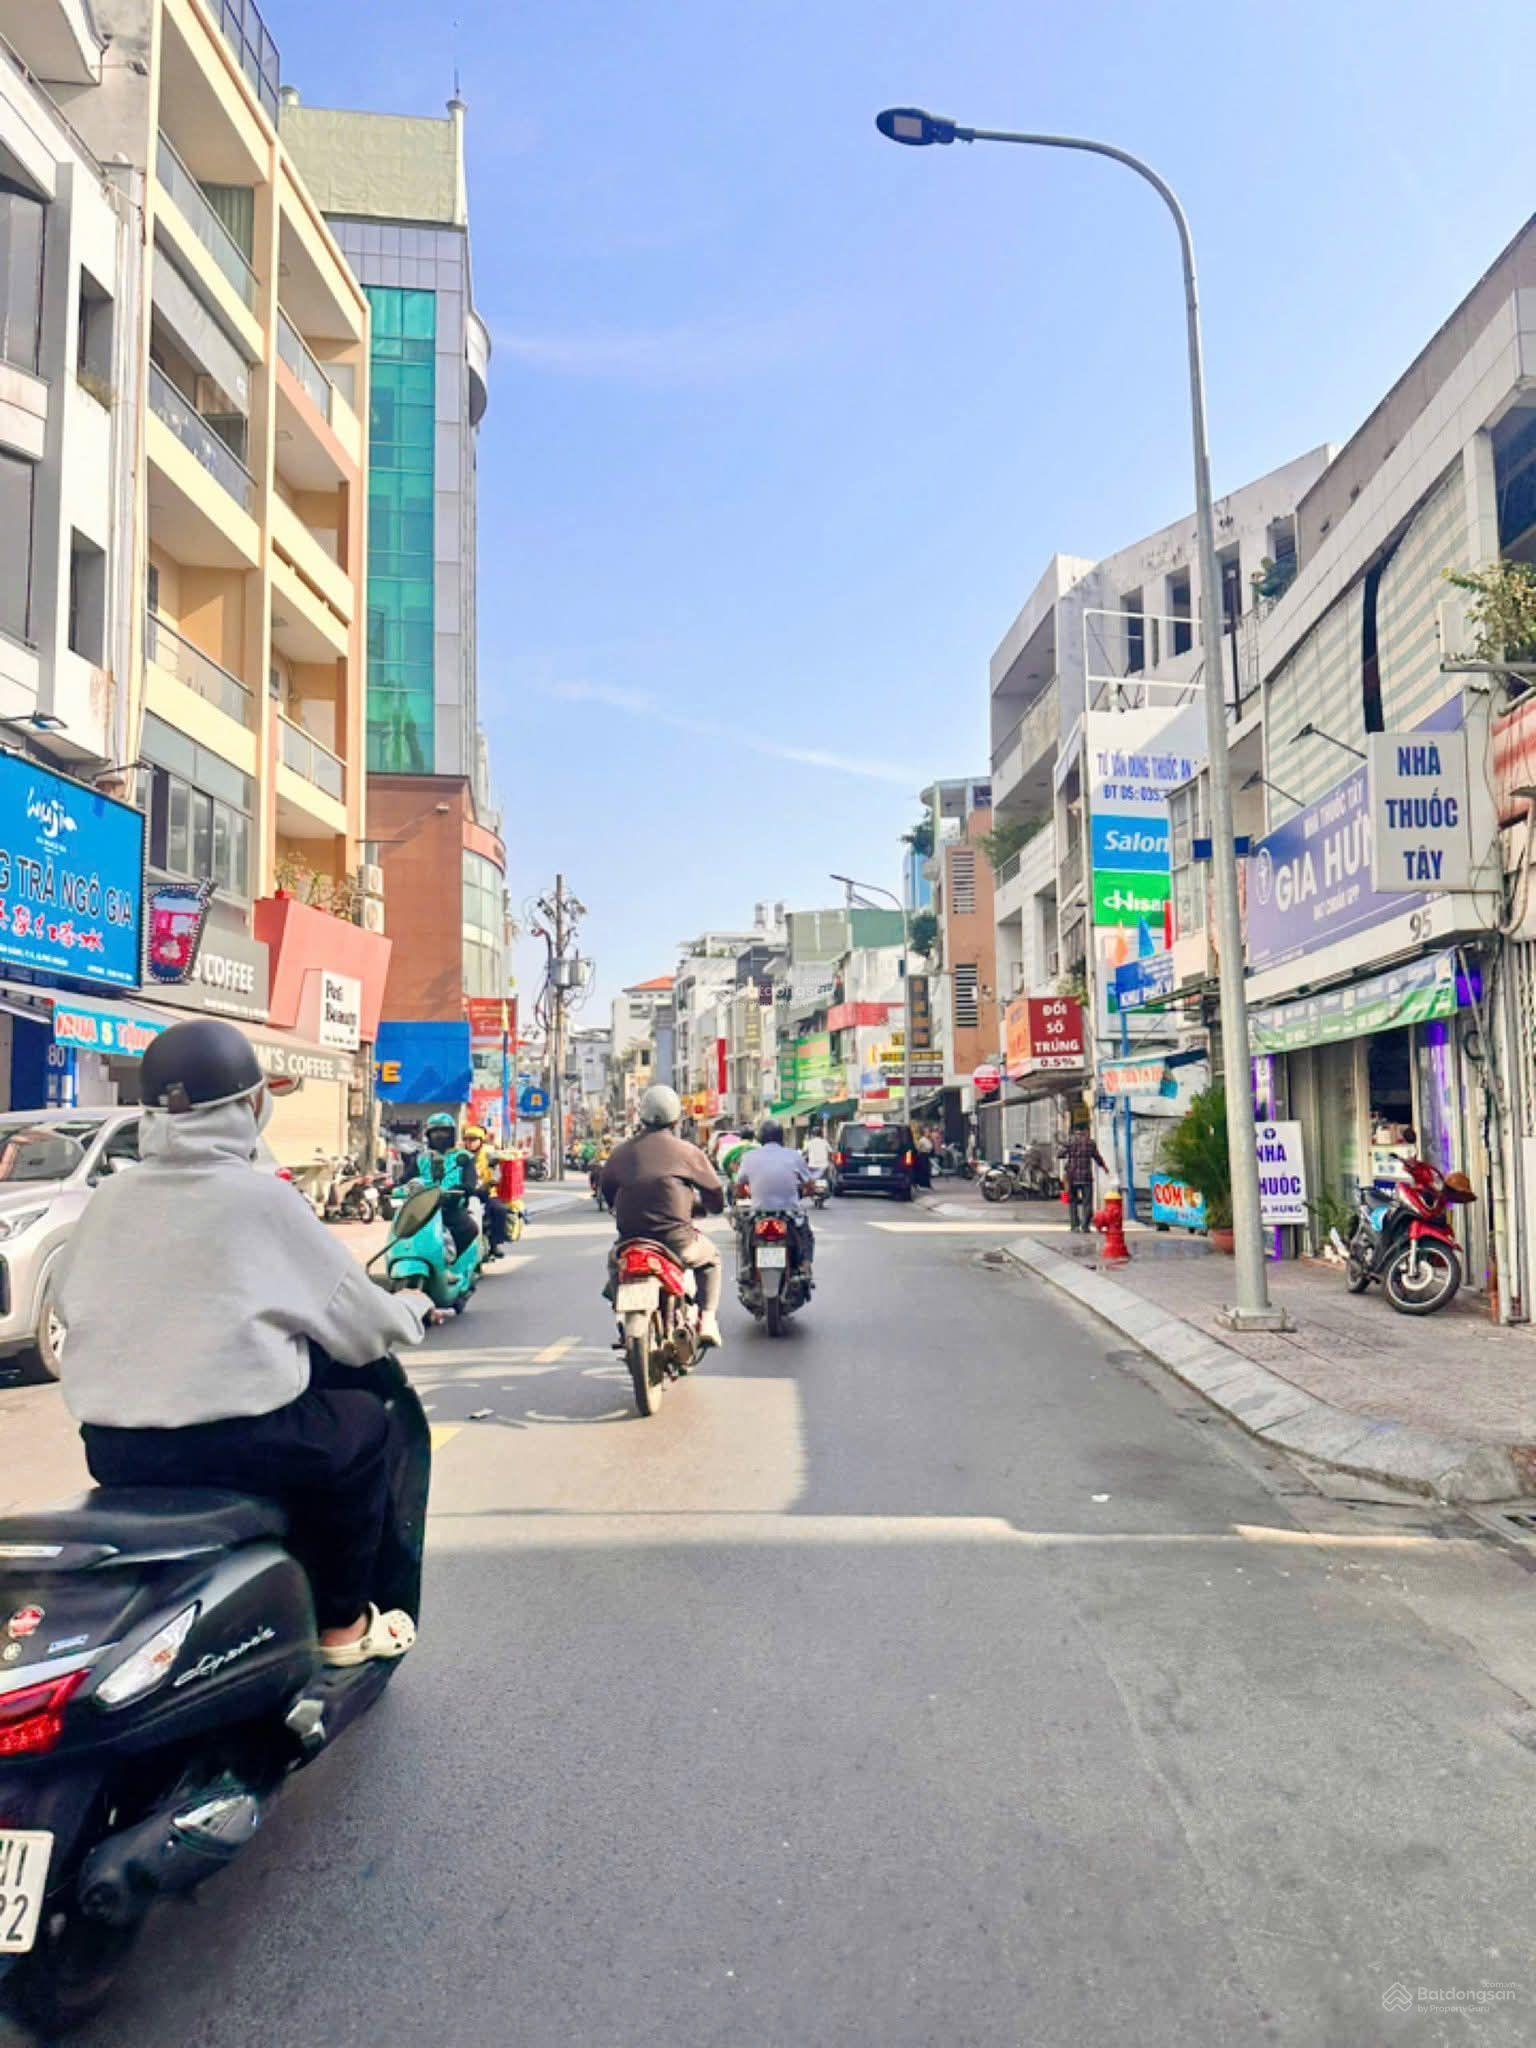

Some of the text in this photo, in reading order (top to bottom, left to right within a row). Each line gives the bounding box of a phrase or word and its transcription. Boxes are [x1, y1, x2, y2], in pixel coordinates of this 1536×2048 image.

[1397, 741, 1441, 776] NHÀ
[1385, 788, 1458, 828] THUỐC
[1403, 845, 1443, 880] TÂY
[17, 854, 56, 906] TRÀ
[61, 869, 100, 920] NGÔ
[104, 887, 135, 930] GIA
[1275, 852, 1318, 912] GIA
[1409, 908, 1433, 942] 95
[200, 952, 255, 992] COFFEE
[48, 1044, 65, 1067] 80
[288, 1053, 334, 1078] COFFEE
[1040, 1057, 1076, 1068] 0.5%
[1259, 1172, 1301, 1196] HUỐC
